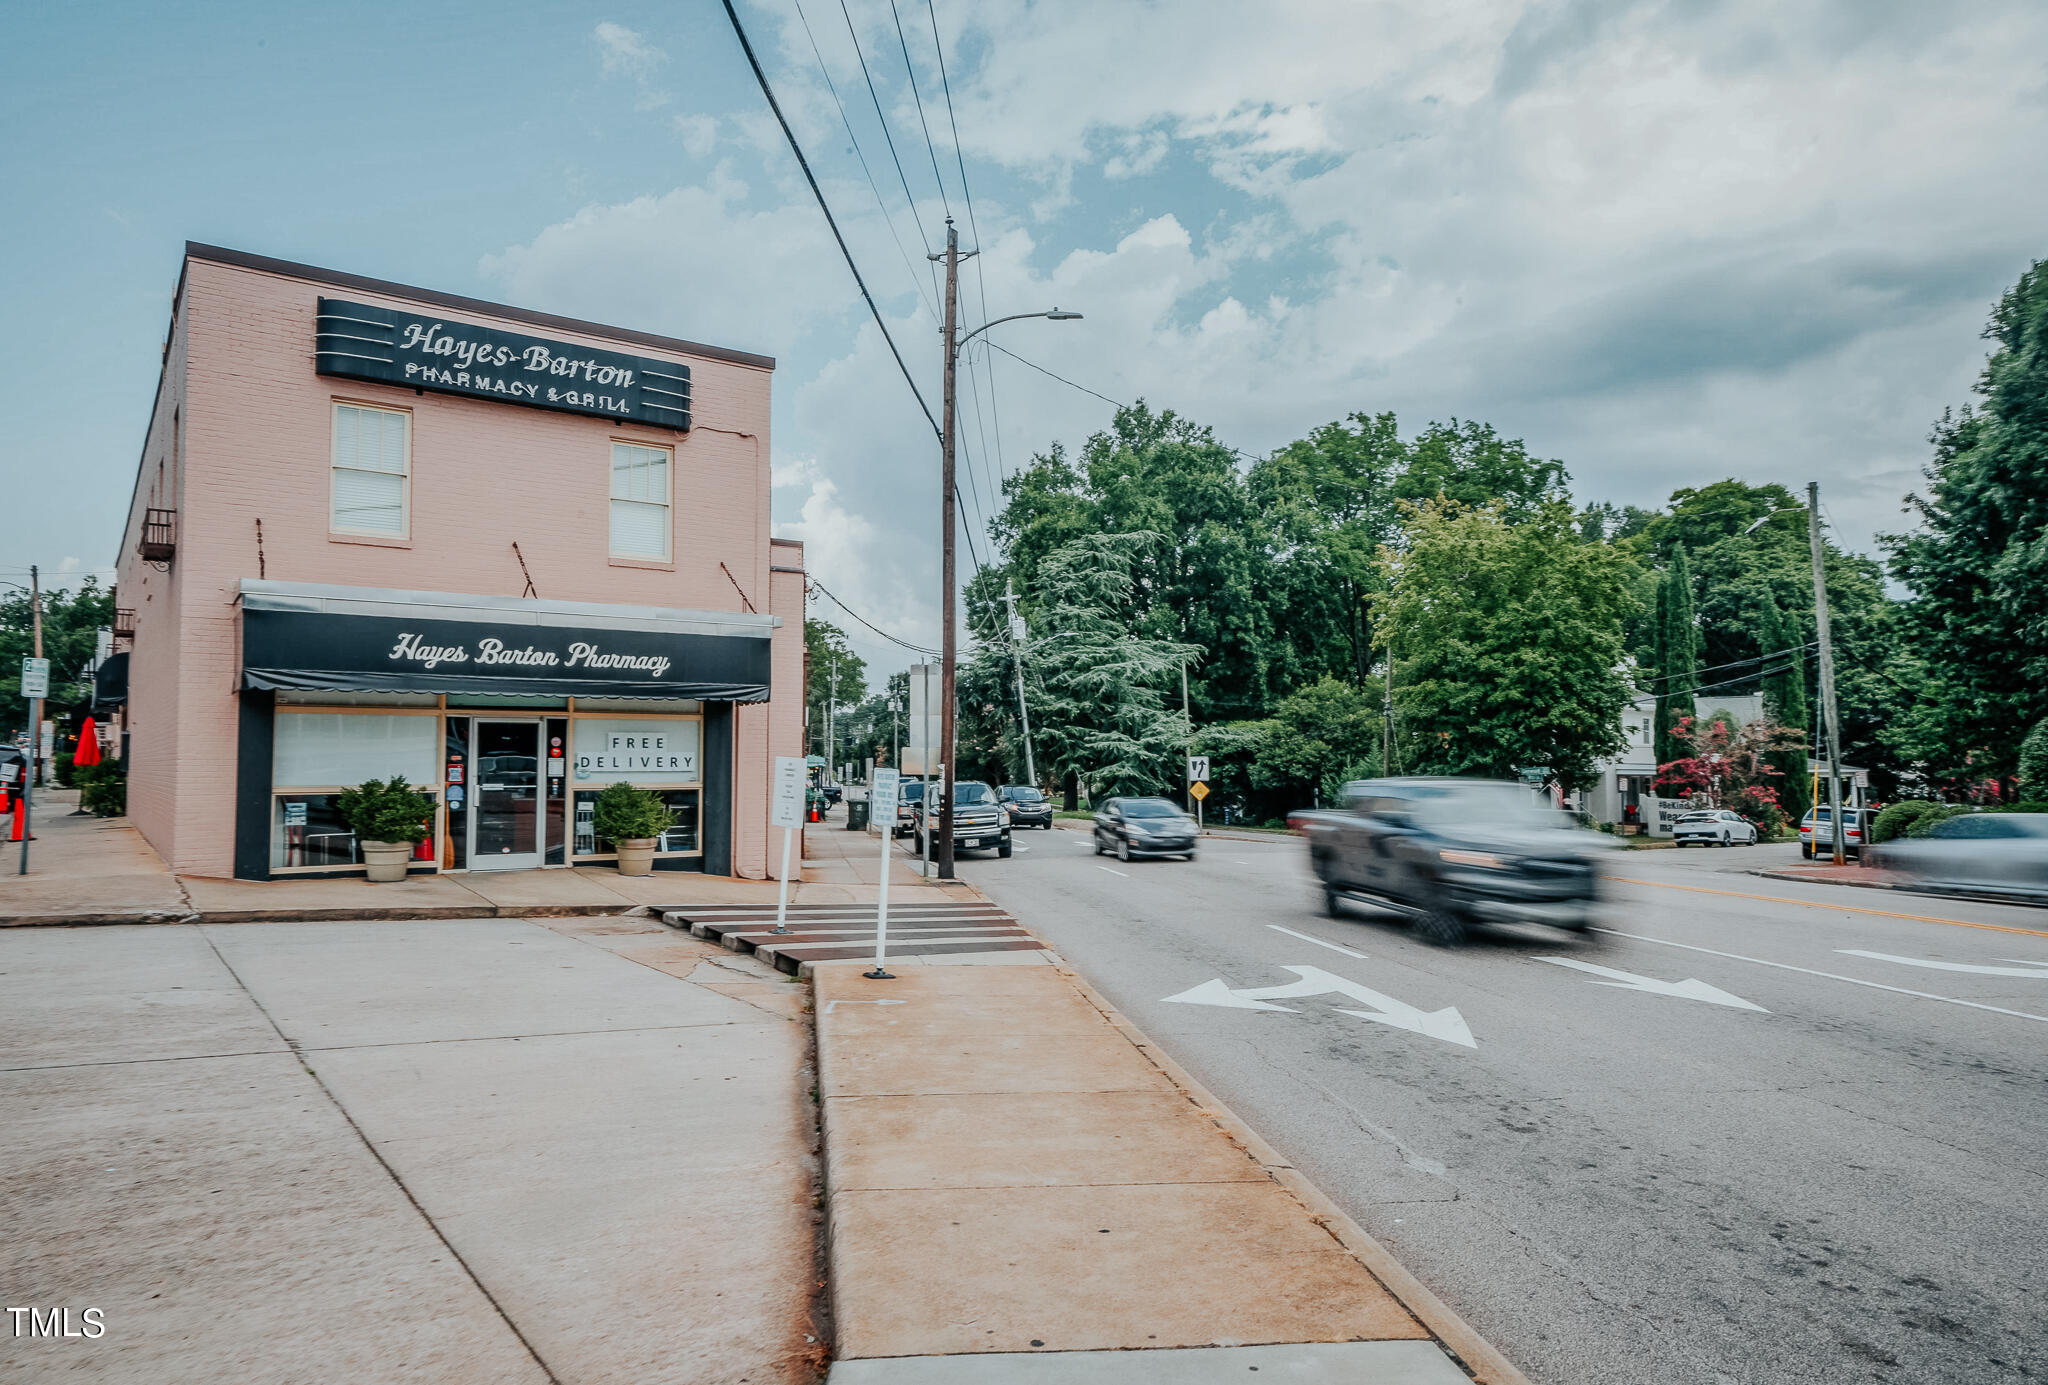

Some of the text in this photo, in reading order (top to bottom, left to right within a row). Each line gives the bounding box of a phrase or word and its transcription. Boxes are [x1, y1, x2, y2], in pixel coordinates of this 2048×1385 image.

[405, 362, 631, 414] PHARMACY & GRILL
[388, 632, 671, 678] Hayes Barton Pharmacy
[612, 737, 665, 749] FREE
[580, 756, 693, 768] DELIVERY
